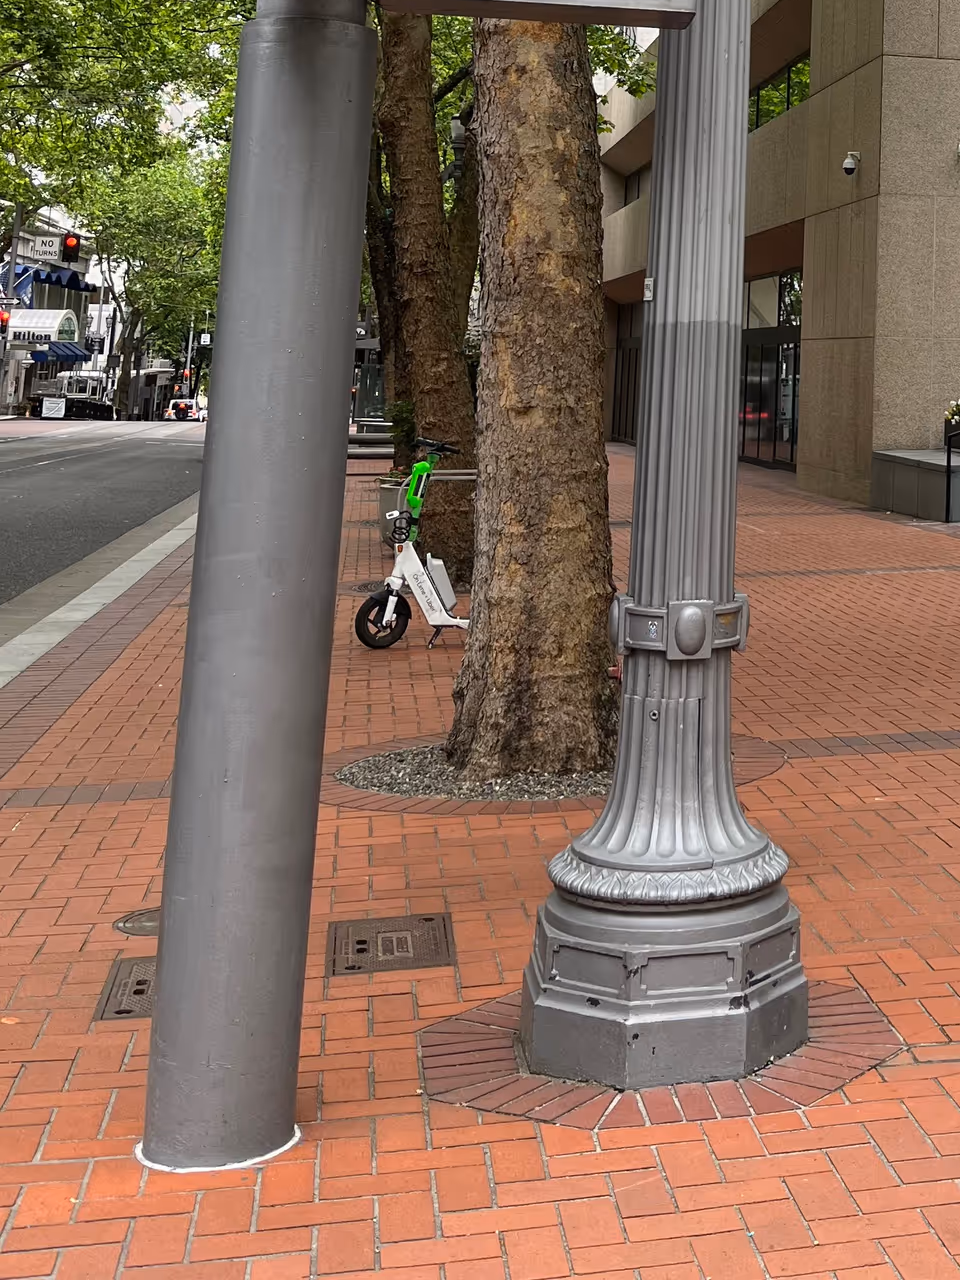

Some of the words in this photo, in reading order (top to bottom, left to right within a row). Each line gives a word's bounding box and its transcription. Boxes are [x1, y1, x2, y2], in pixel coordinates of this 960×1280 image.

[40, 239, 54, 248] NO
[34, 249, 57, 257] TURNS
[13, 331, 51, 341] Hilton
